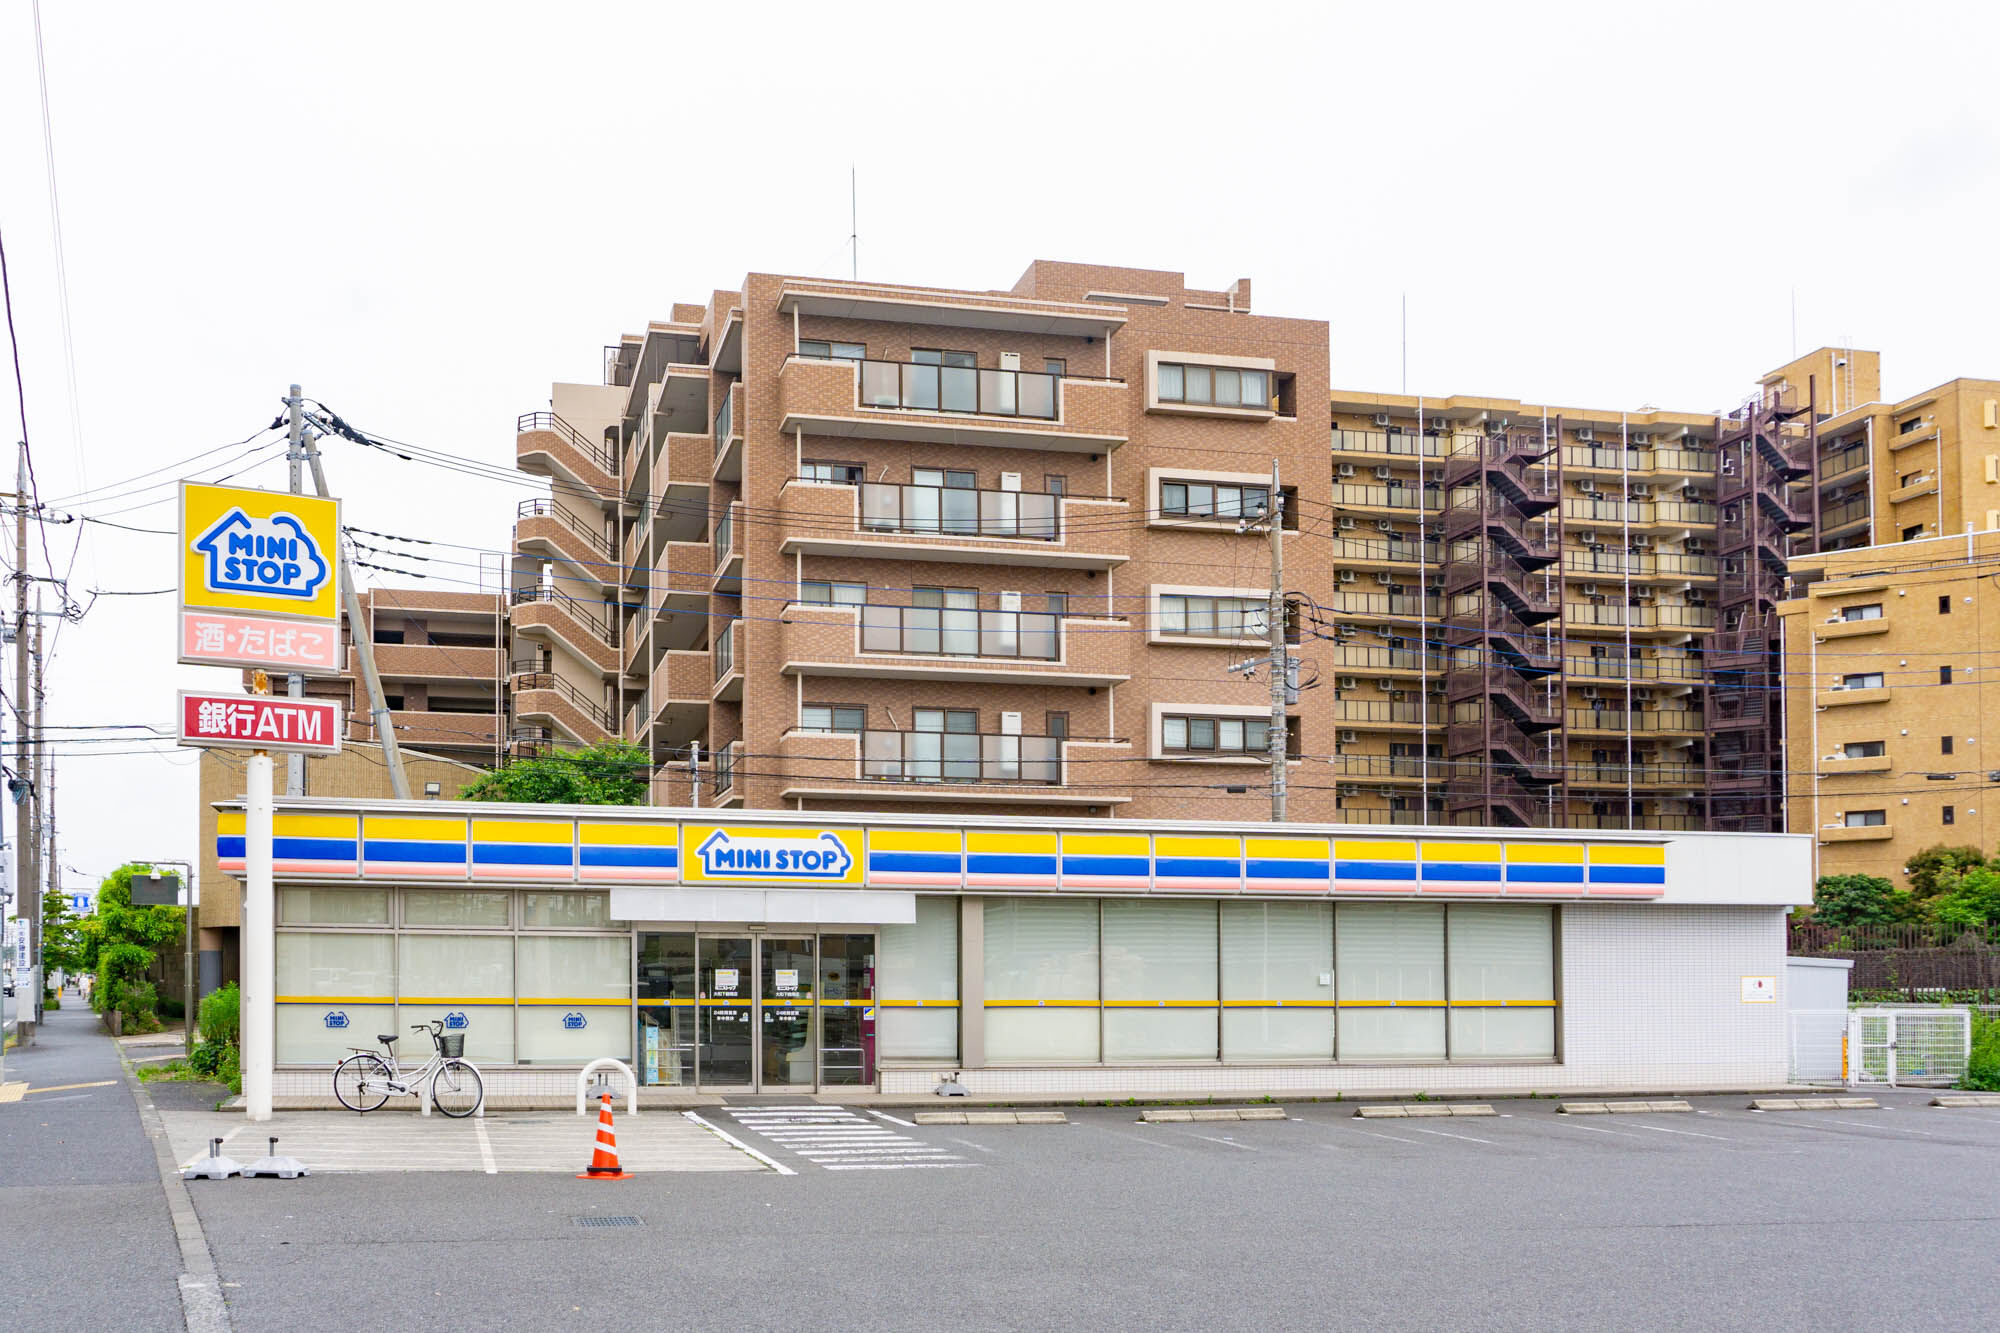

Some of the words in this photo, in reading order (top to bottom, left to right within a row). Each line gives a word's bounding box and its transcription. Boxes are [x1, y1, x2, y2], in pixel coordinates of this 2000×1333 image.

[229, 531, 297, 561] MINI
[224, 556, 302, 585] STOP
[194, 621, 325, 661] 酒・たばこ
[198, 700, 322, 742] 銀行ATM
[715, 848, 771, 869] MINI
[775, 849, 838, 871] STOP
